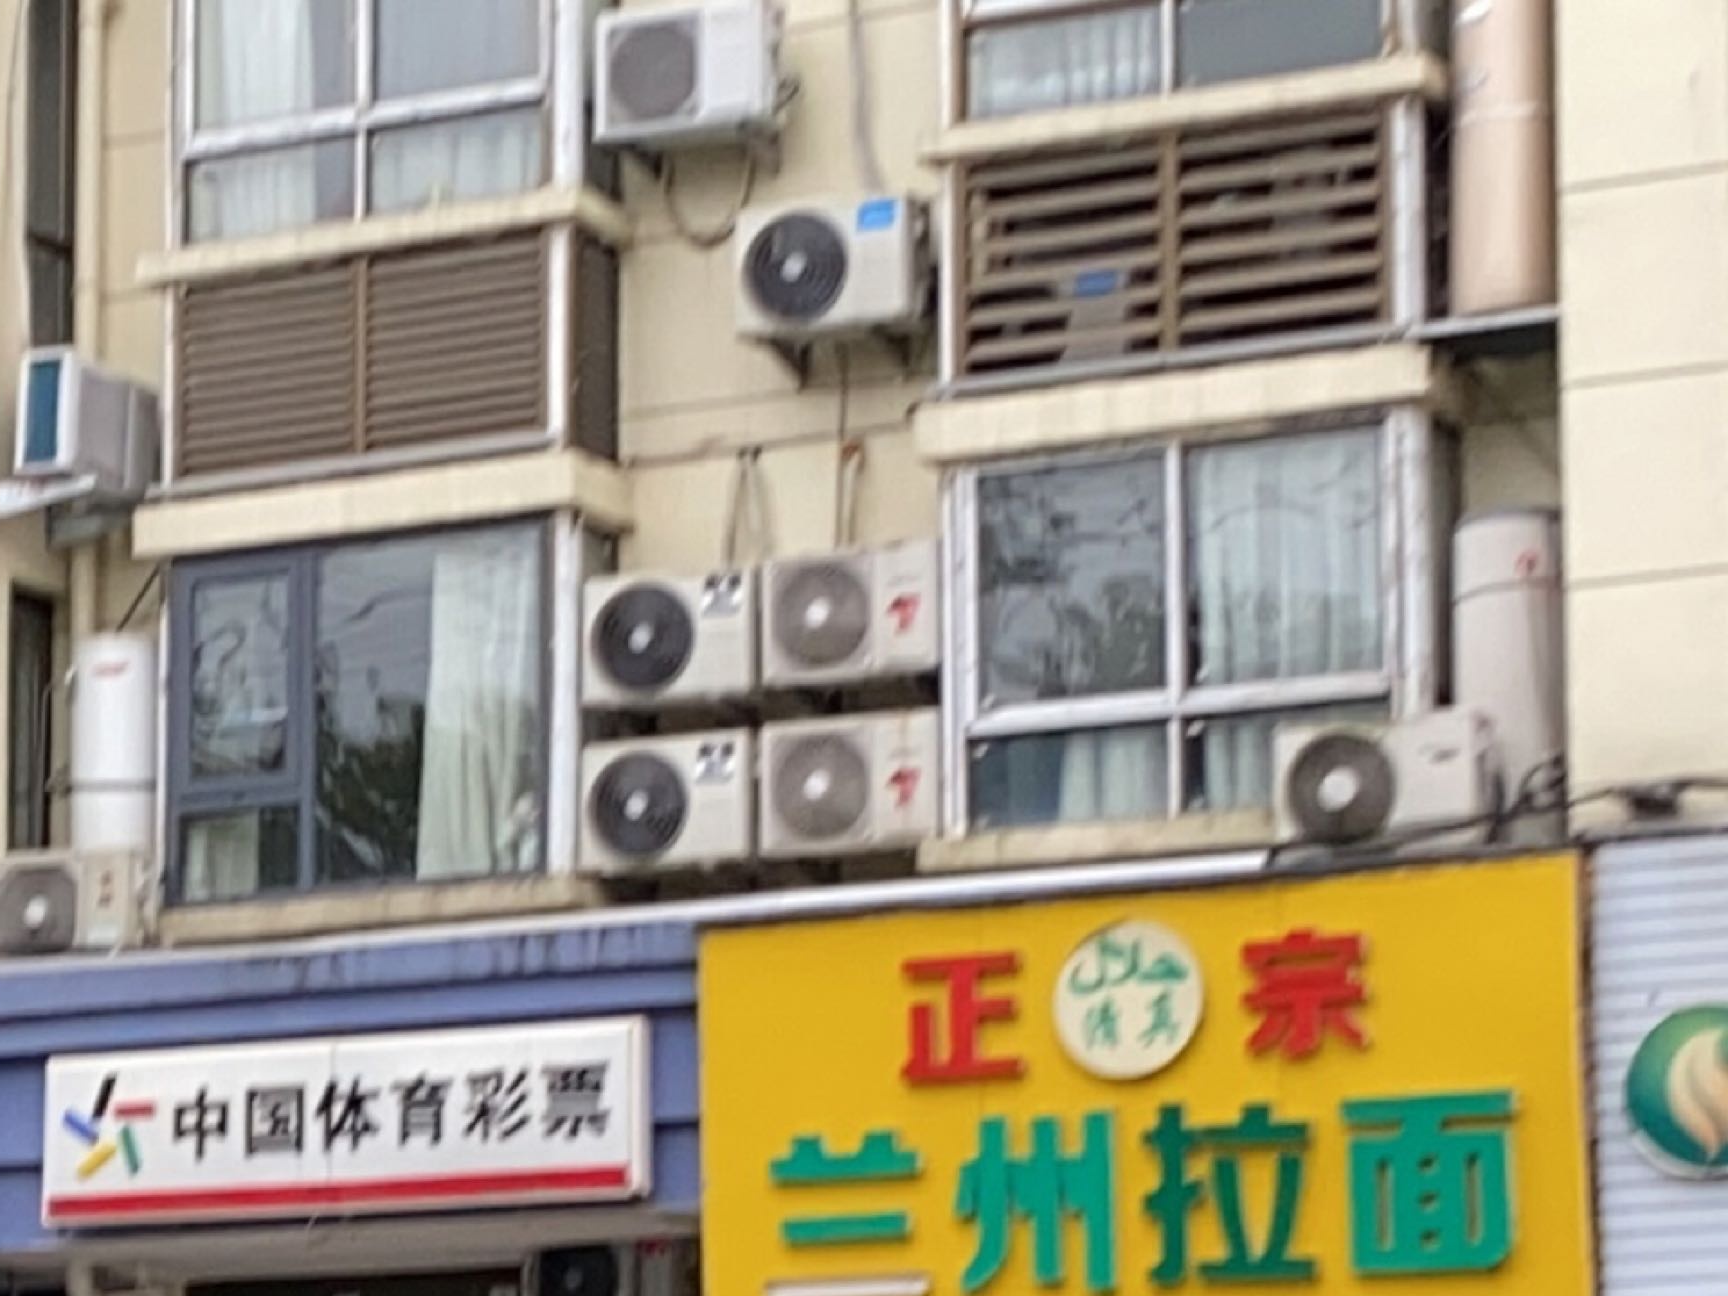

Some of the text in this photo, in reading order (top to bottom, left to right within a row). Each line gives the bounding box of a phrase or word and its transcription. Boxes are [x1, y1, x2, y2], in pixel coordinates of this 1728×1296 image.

[901, 927, 1372, 1087] 正 宗
[171, 1059, 610, 1162] 中国体育彩票
